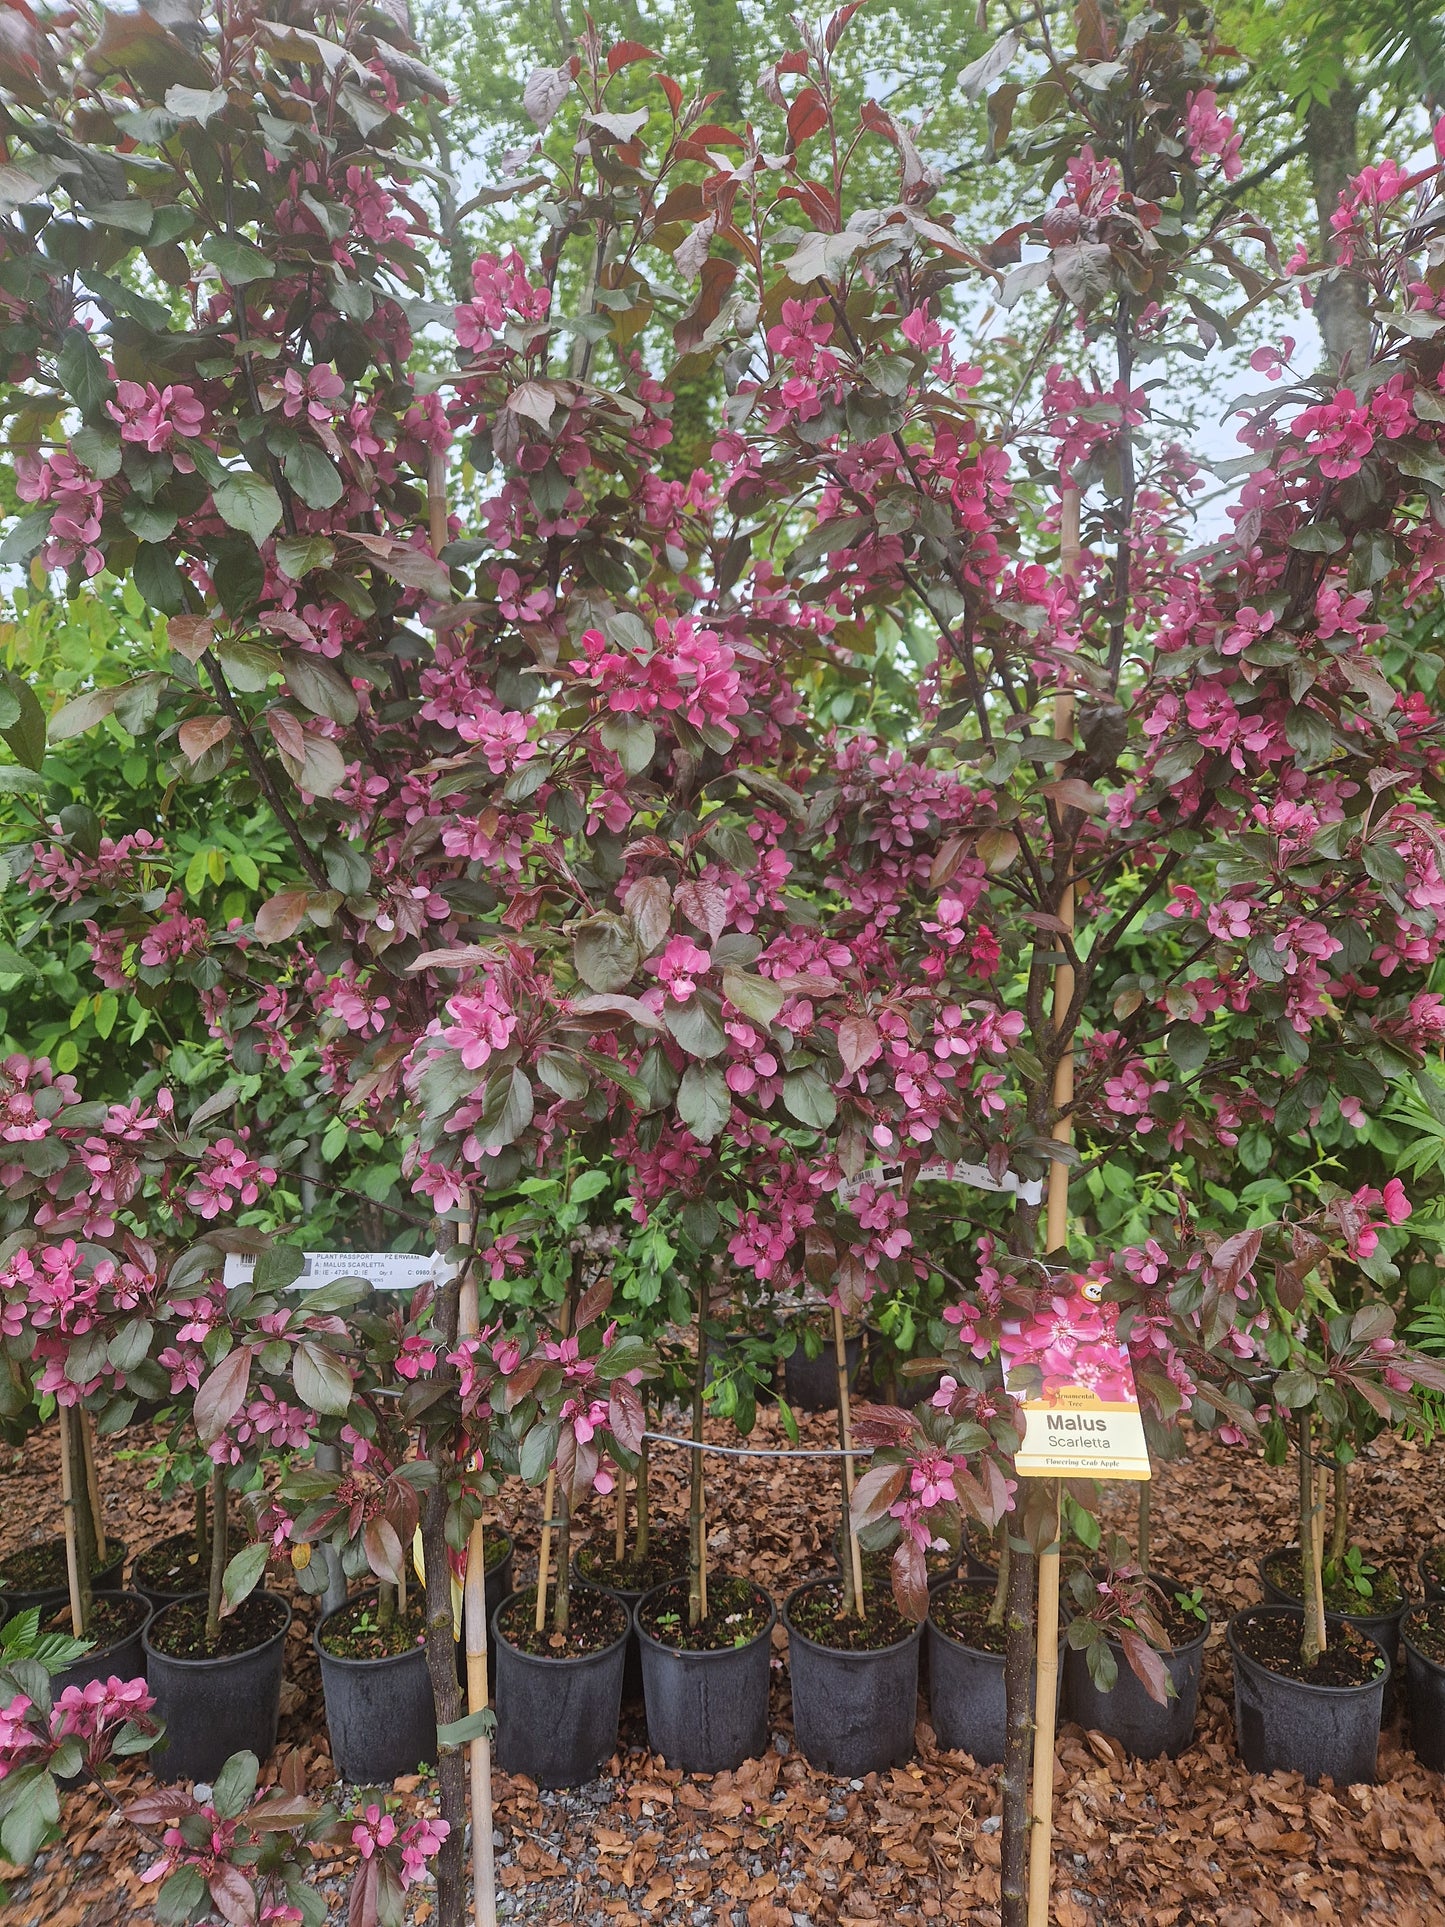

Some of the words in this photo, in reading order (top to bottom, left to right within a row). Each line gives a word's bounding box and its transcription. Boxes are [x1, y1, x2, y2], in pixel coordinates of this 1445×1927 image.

[1046, 1414, 1107, 1432] Malus
[1048, 1435, 1111, 1448] Scarletta
[1046, 1458, 1079, 1466] Flowering
